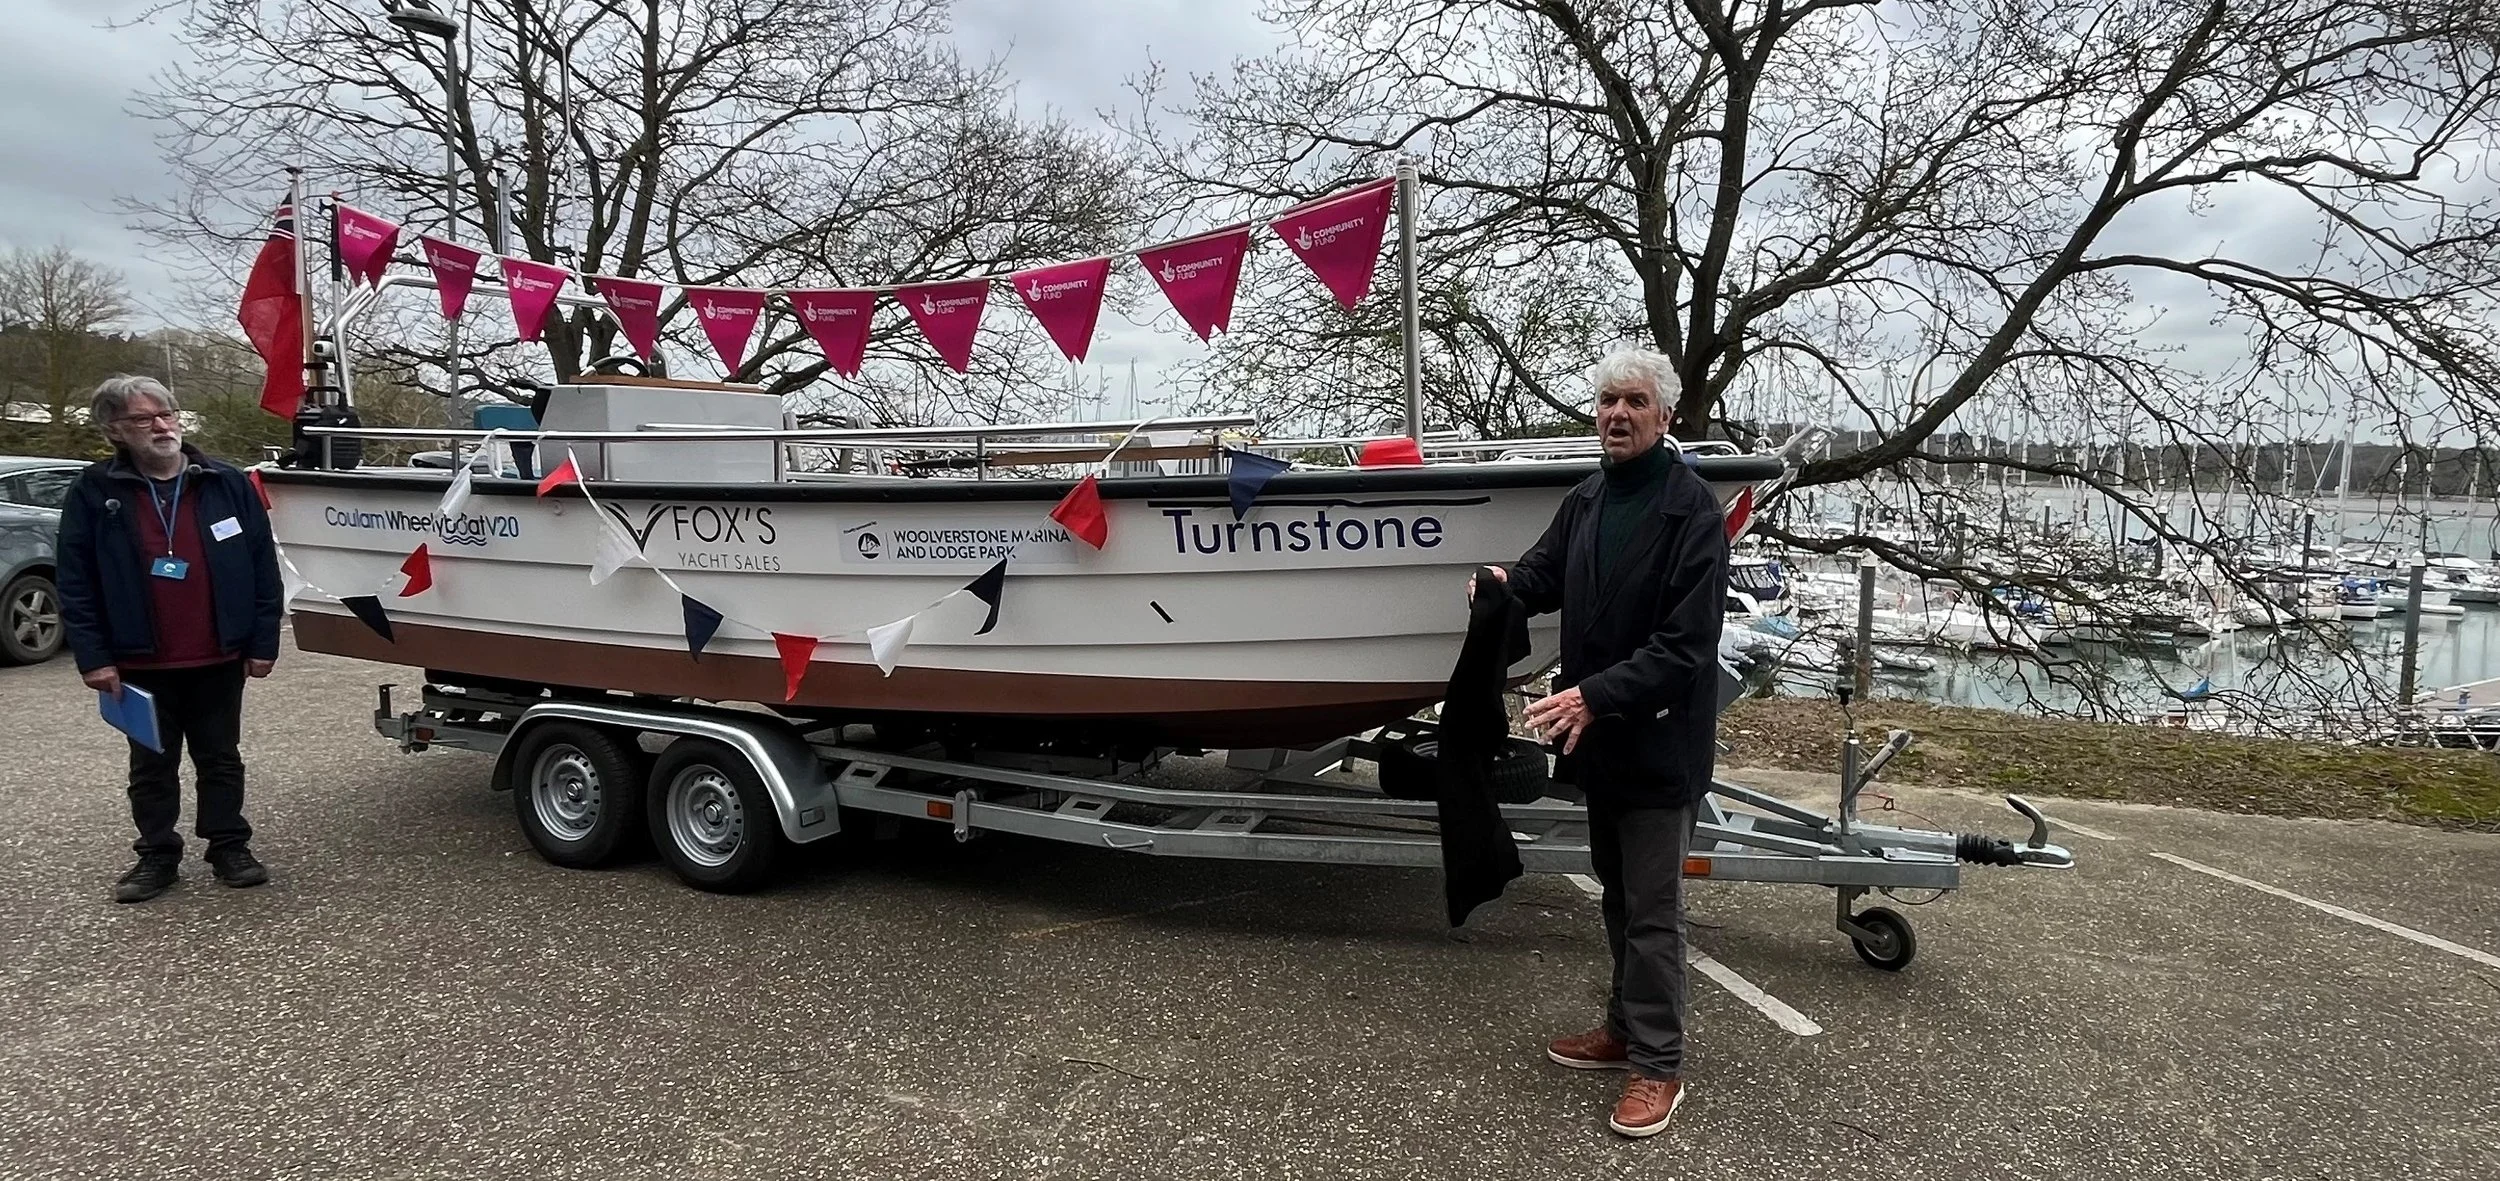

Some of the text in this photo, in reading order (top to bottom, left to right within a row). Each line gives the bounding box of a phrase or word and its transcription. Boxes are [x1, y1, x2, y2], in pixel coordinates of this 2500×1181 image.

[1313, 217, 1364, 239] COMMUNITY
[1314, 234, 1336, 247] FUND
[1176, 256, 1223, 273] COMMUNITY
[1177, 270, 1197, 280] FUND
[1042, 279, 1088, 293] COMMUNITY
[936, 296, 979, 307] COMMUNITY
[1043, 291, 1062, 300] FUND
[672, 505, 777, 546] FOX'S
[1162, 509, 1443, 554] Turnstone
[893, 528, 1072, 544] WOOLVERSTONE MARINA
[896, 544, 1017, 559] AND LODGE PARK
[677, 552, 782, 572] YACHT SALES
